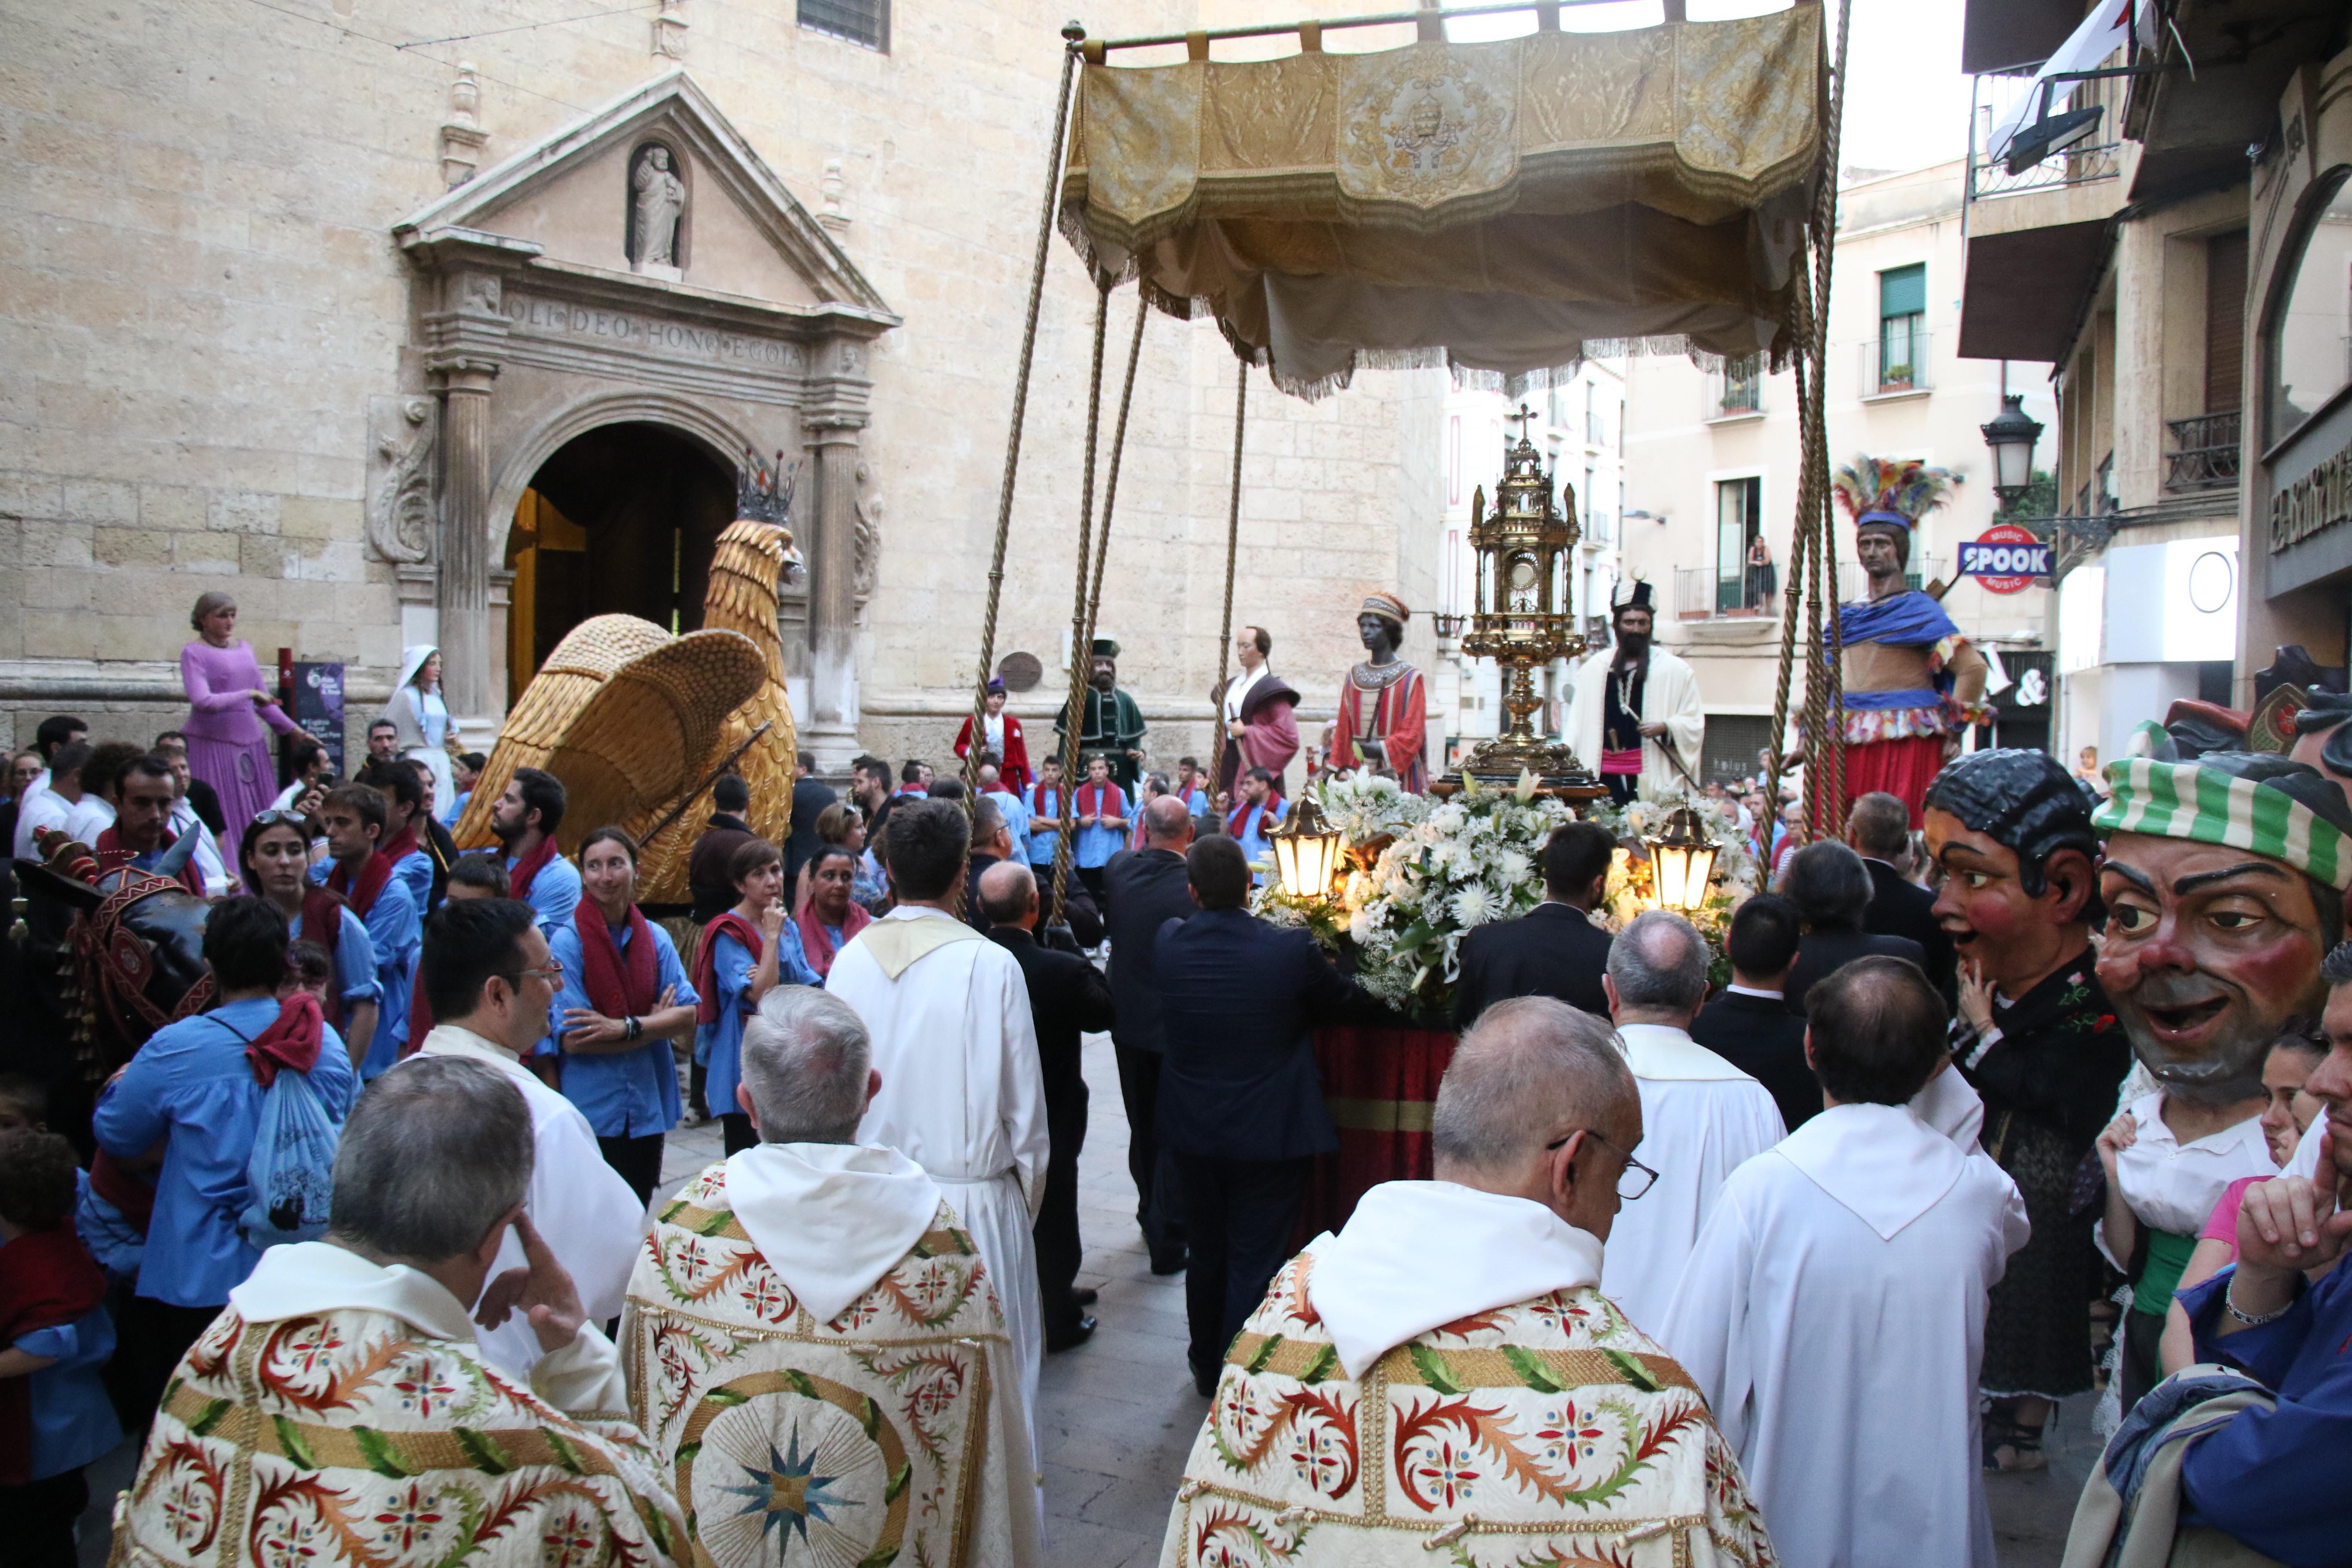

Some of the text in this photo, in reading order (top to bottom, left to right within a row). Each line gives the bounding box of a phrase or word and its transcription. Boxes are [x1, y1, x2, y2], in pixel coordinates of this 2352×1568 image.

[573, 309, 628, 338] DEO
[1991, 531, 2023, 542] MUSIC
[1963, 547, 2048, 573] SPOOK
[1986, 577, 2022, 589] MUSIC
